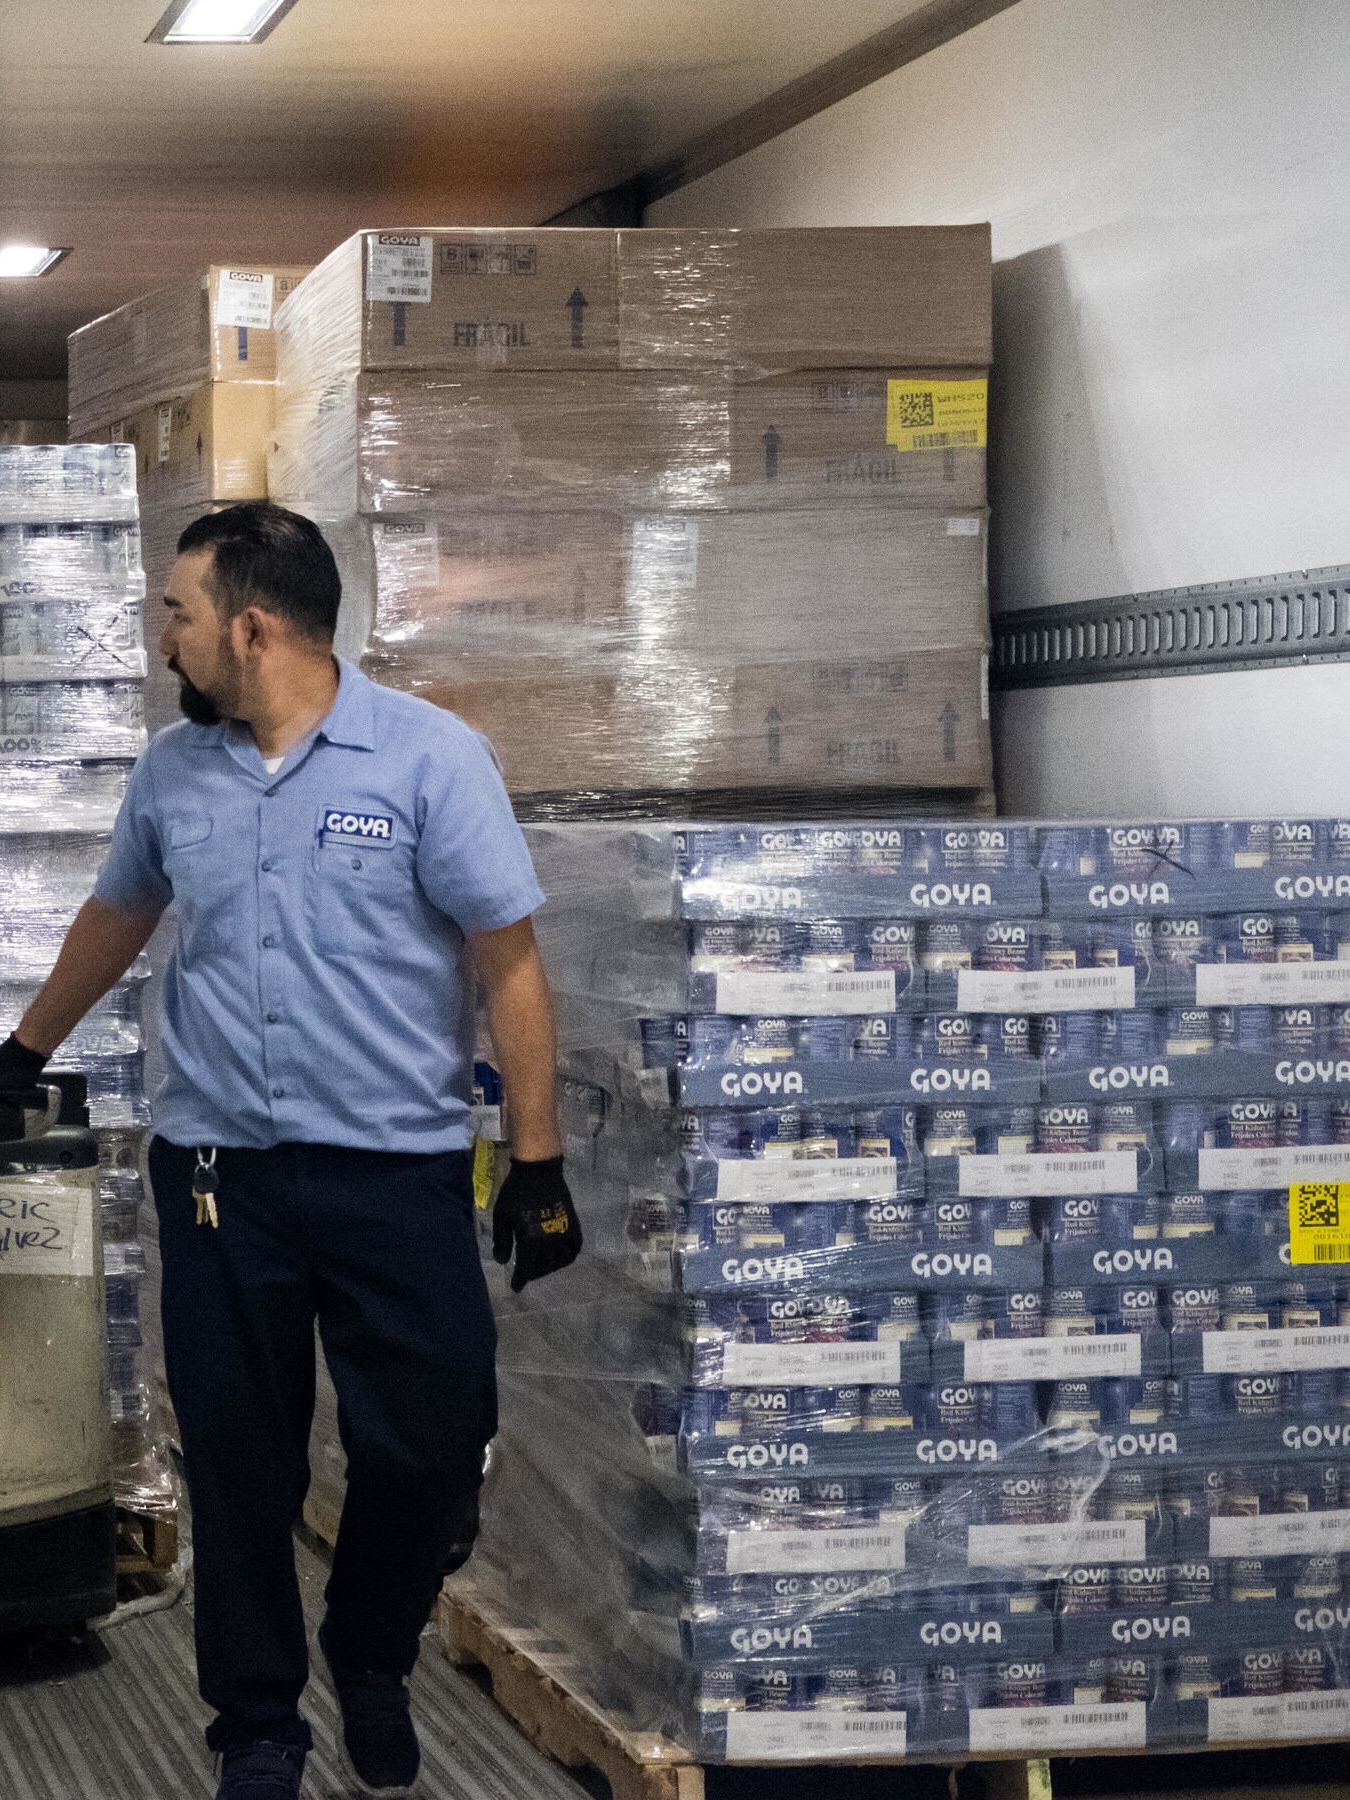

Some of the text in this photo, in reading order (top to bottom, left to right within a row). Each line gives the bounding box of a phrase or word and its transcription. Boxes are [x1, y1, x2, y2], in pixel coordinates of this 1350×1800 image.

[381, 235, 418, 245] GOYA
[230, 272, 263, 282] GOYA
[326, 813, 390, 838] GOYA
[721, 886, 801, 911] GOYA
[910, 883, 992, 908] GOYA
[1088, 882, 1170, 908] GOYA
[1274, 875, 1350, 900] GOYA
[986, 927, 1026, 943] OYA
[1160, 920, 1199, 937] OYA
[721, 1071, 803, 1097] GOYA
[910, 1068, 991, 1093] GOYA
[1089, 1065, 1170, 1091] GOYA
[1275, 1060, 1350, 1086] GOYA
[722, 1257, 804, 1283] GOYA
[911, 1253, 993, 1278] GOYA
[1093, 1248, 1173, 1274] GOYA
[727, 1443, 809, 1469] GOYA
[916, 1439, 998, 1464] GOYA
[1098, 1432, 1178, 1459] GOYA
[1112, 1616, 1191, 1643] GOYA
[1295, 1608, 1350, 1633] GOY
[730, 1626, 812, 1651] GOYA
[920, 1621, 1002, 1646] GOYA
